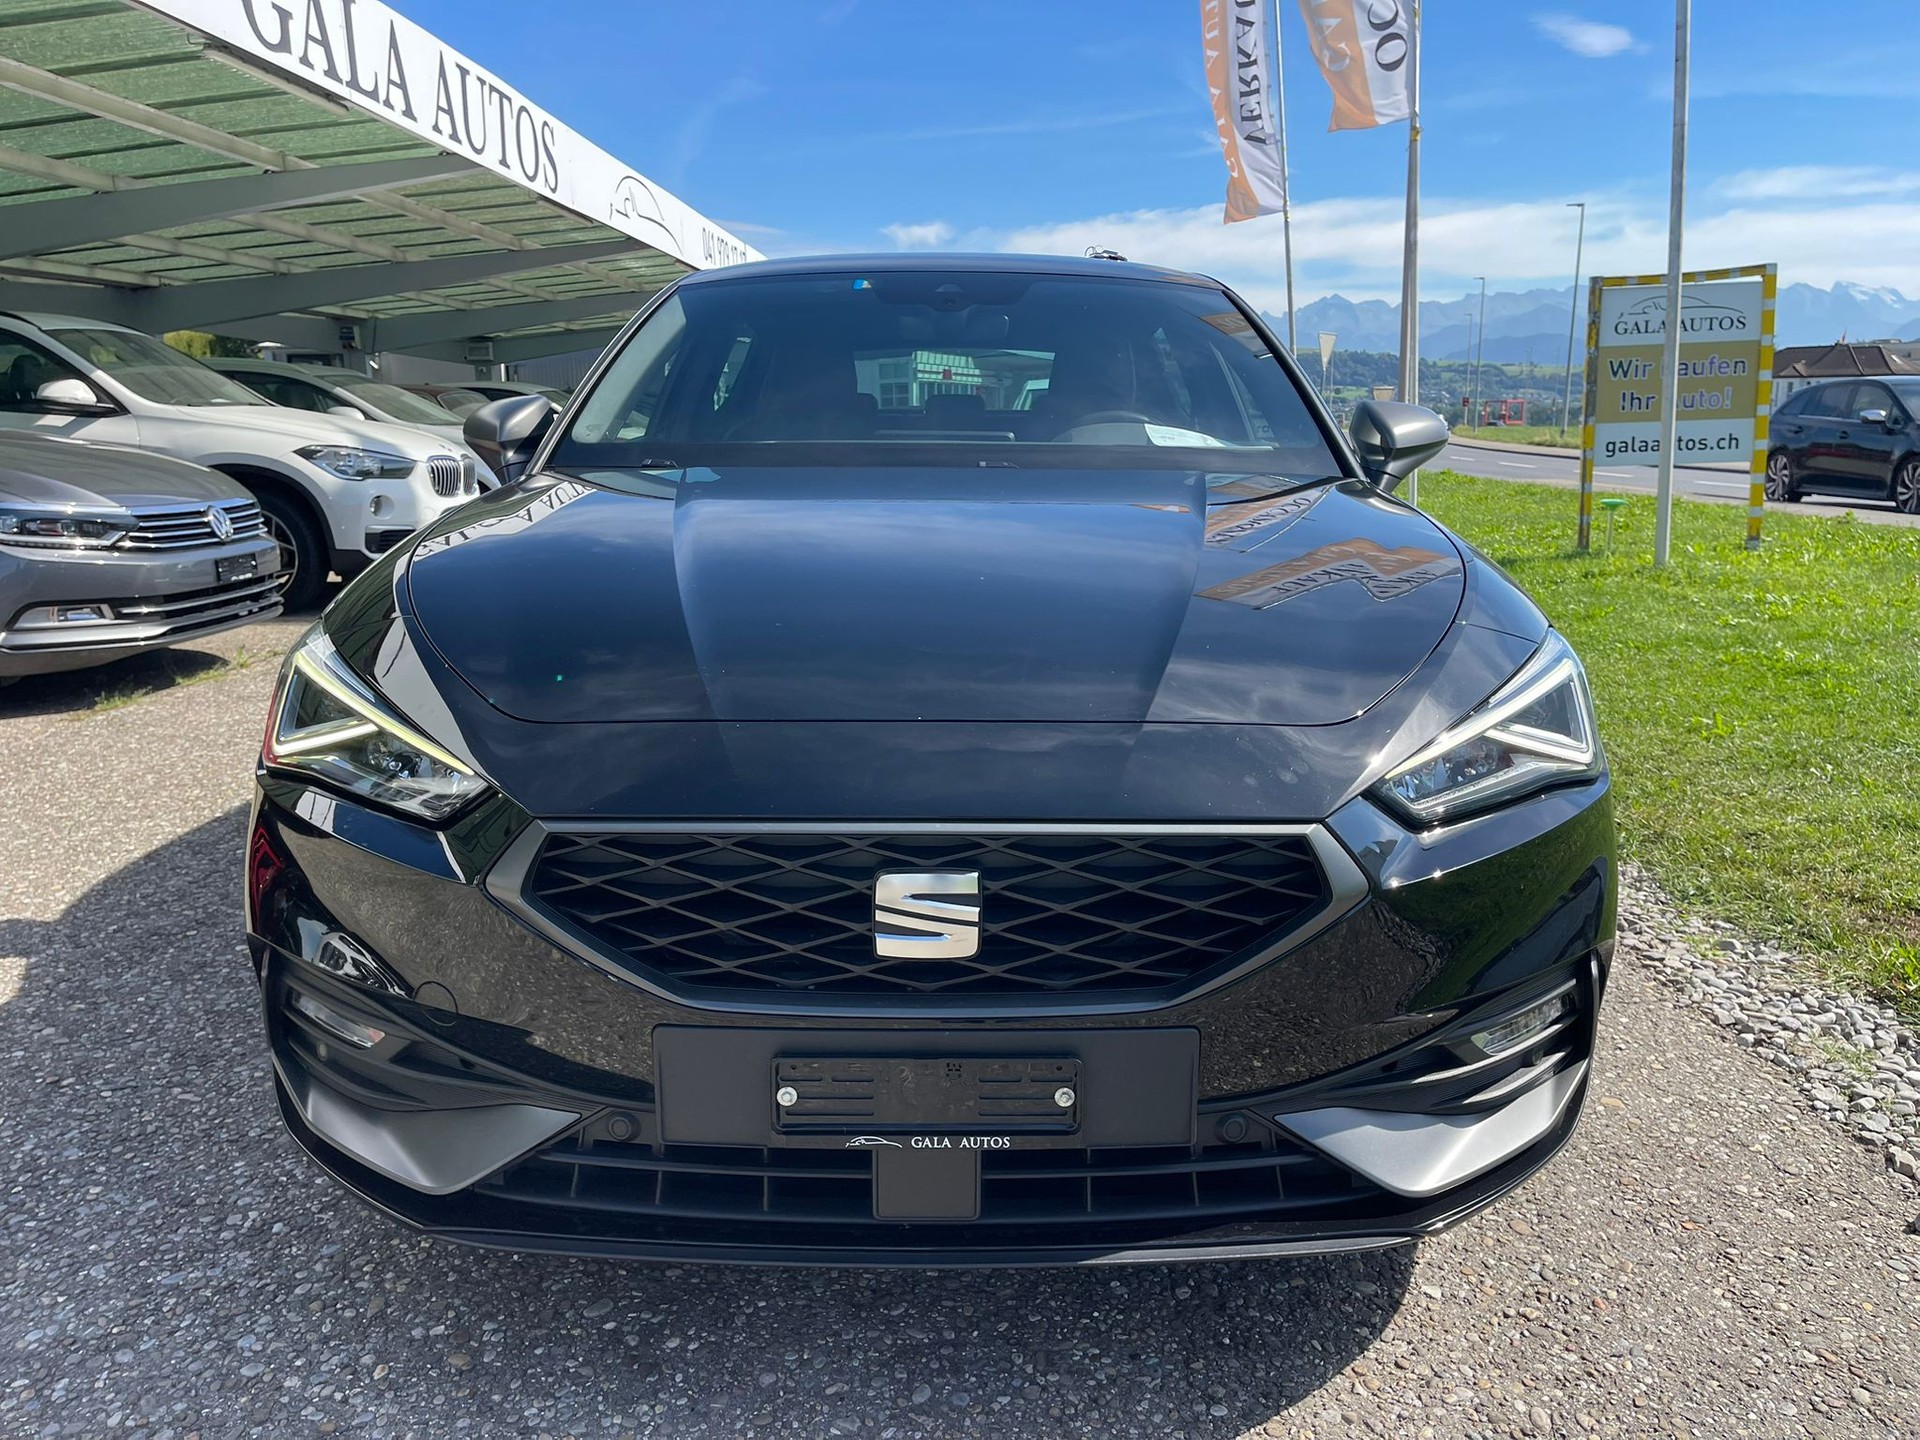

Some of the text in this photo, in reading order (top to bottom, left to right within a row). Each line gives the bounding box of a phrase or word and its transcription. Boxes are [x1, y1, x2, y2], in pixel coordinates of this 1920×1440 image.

[242, 0, 559, 194] GALA AUTOS
[1608, 354, 1748, 380] Wir aufen
[1675, 386, 1734, 410] uto!
[1605, 433, 1740, 458] galaatos.ch
[911, 1136, 1011, 1149] GALA AUTOS
